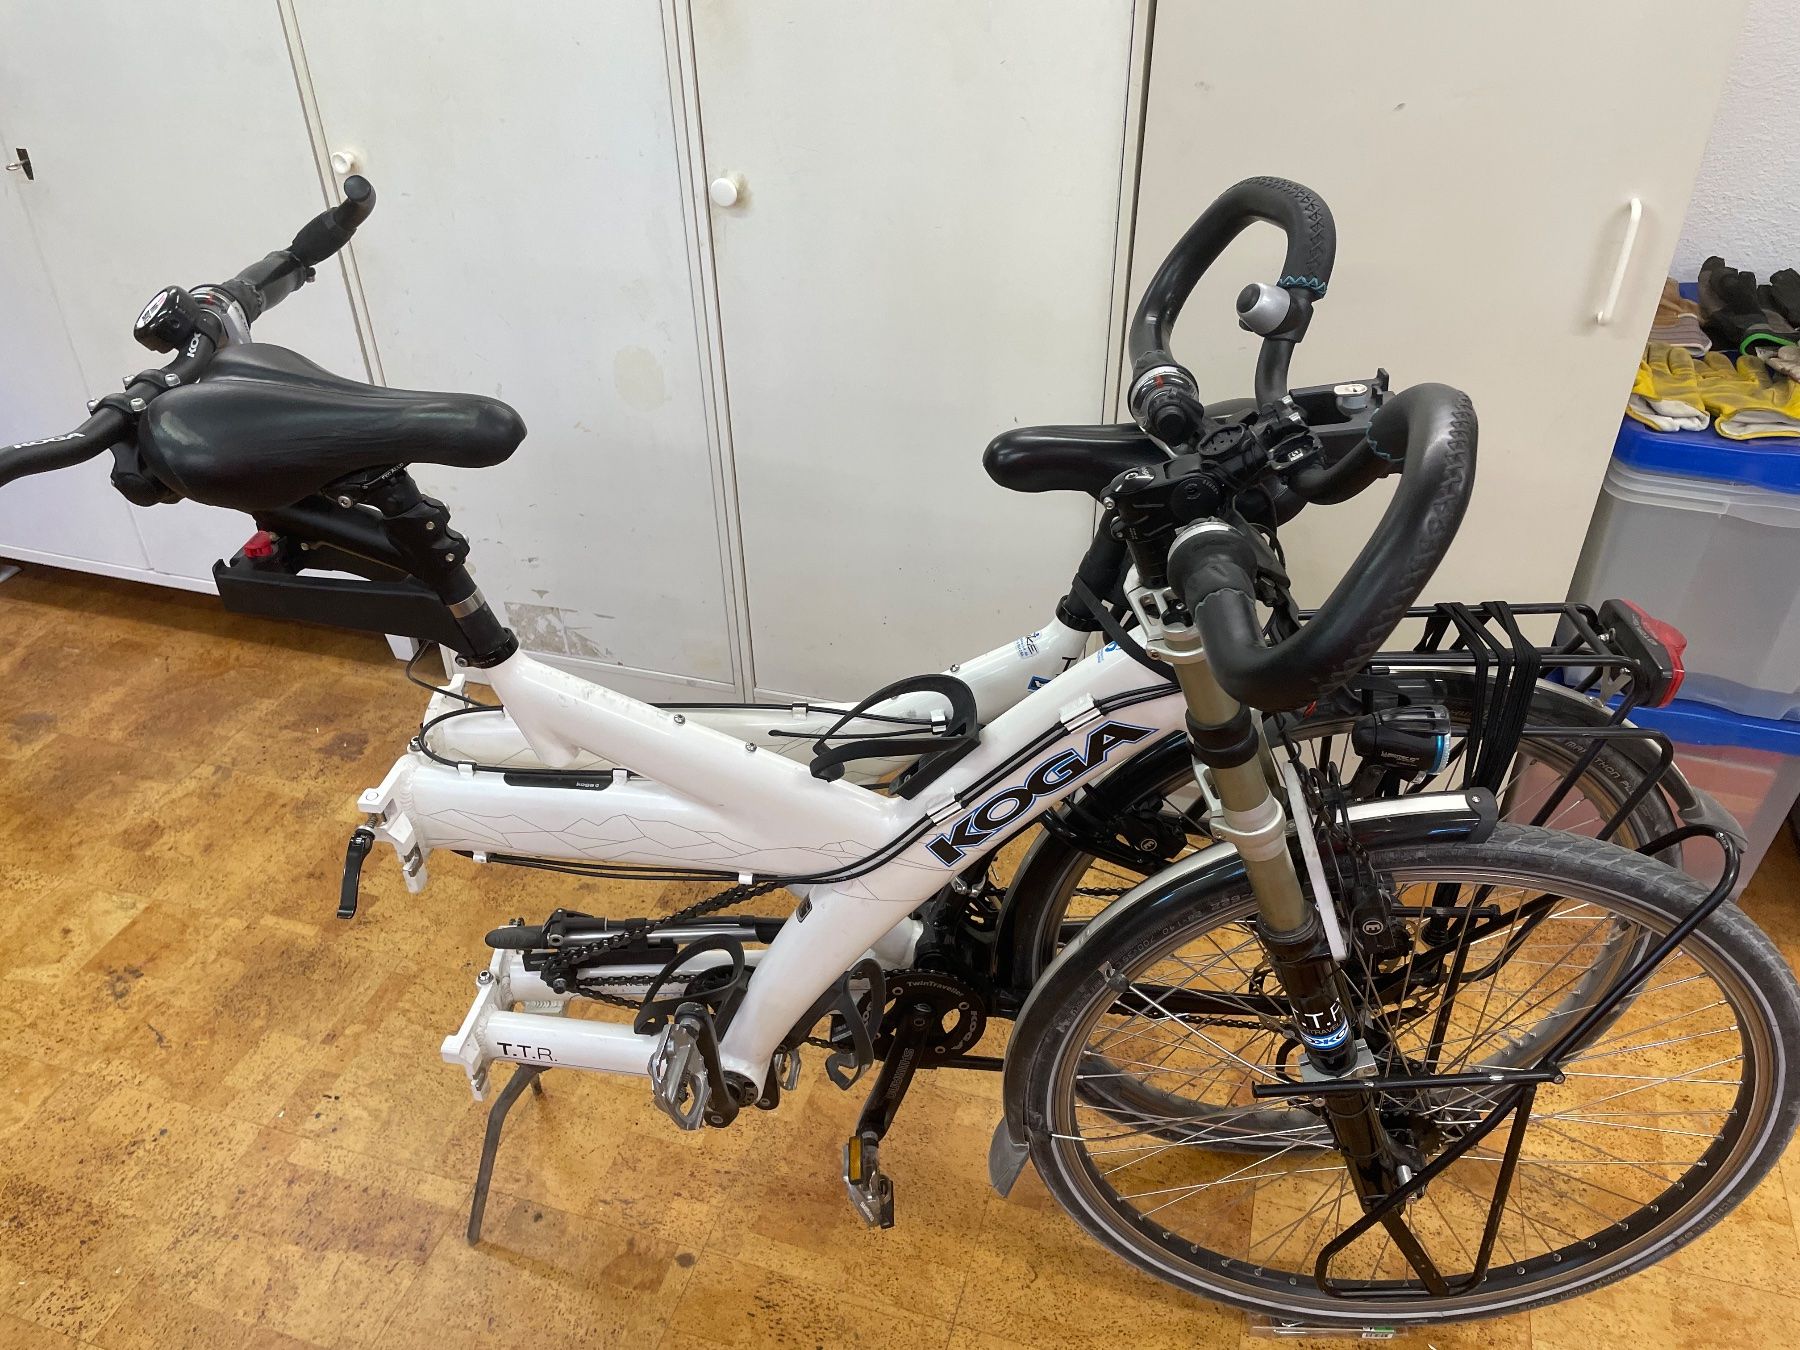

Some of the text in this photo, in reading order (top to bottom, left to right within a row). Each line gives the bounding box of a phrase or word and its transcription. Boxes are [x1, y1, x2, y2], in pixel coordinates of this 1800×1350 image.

[926, 720, 1160, 867] KOGA
[906, 981, 965, 997] TwinTraveller
[951, 1011, 977, 1050] KOGA
[497, 1042, 558, 1061] T.T.R.
